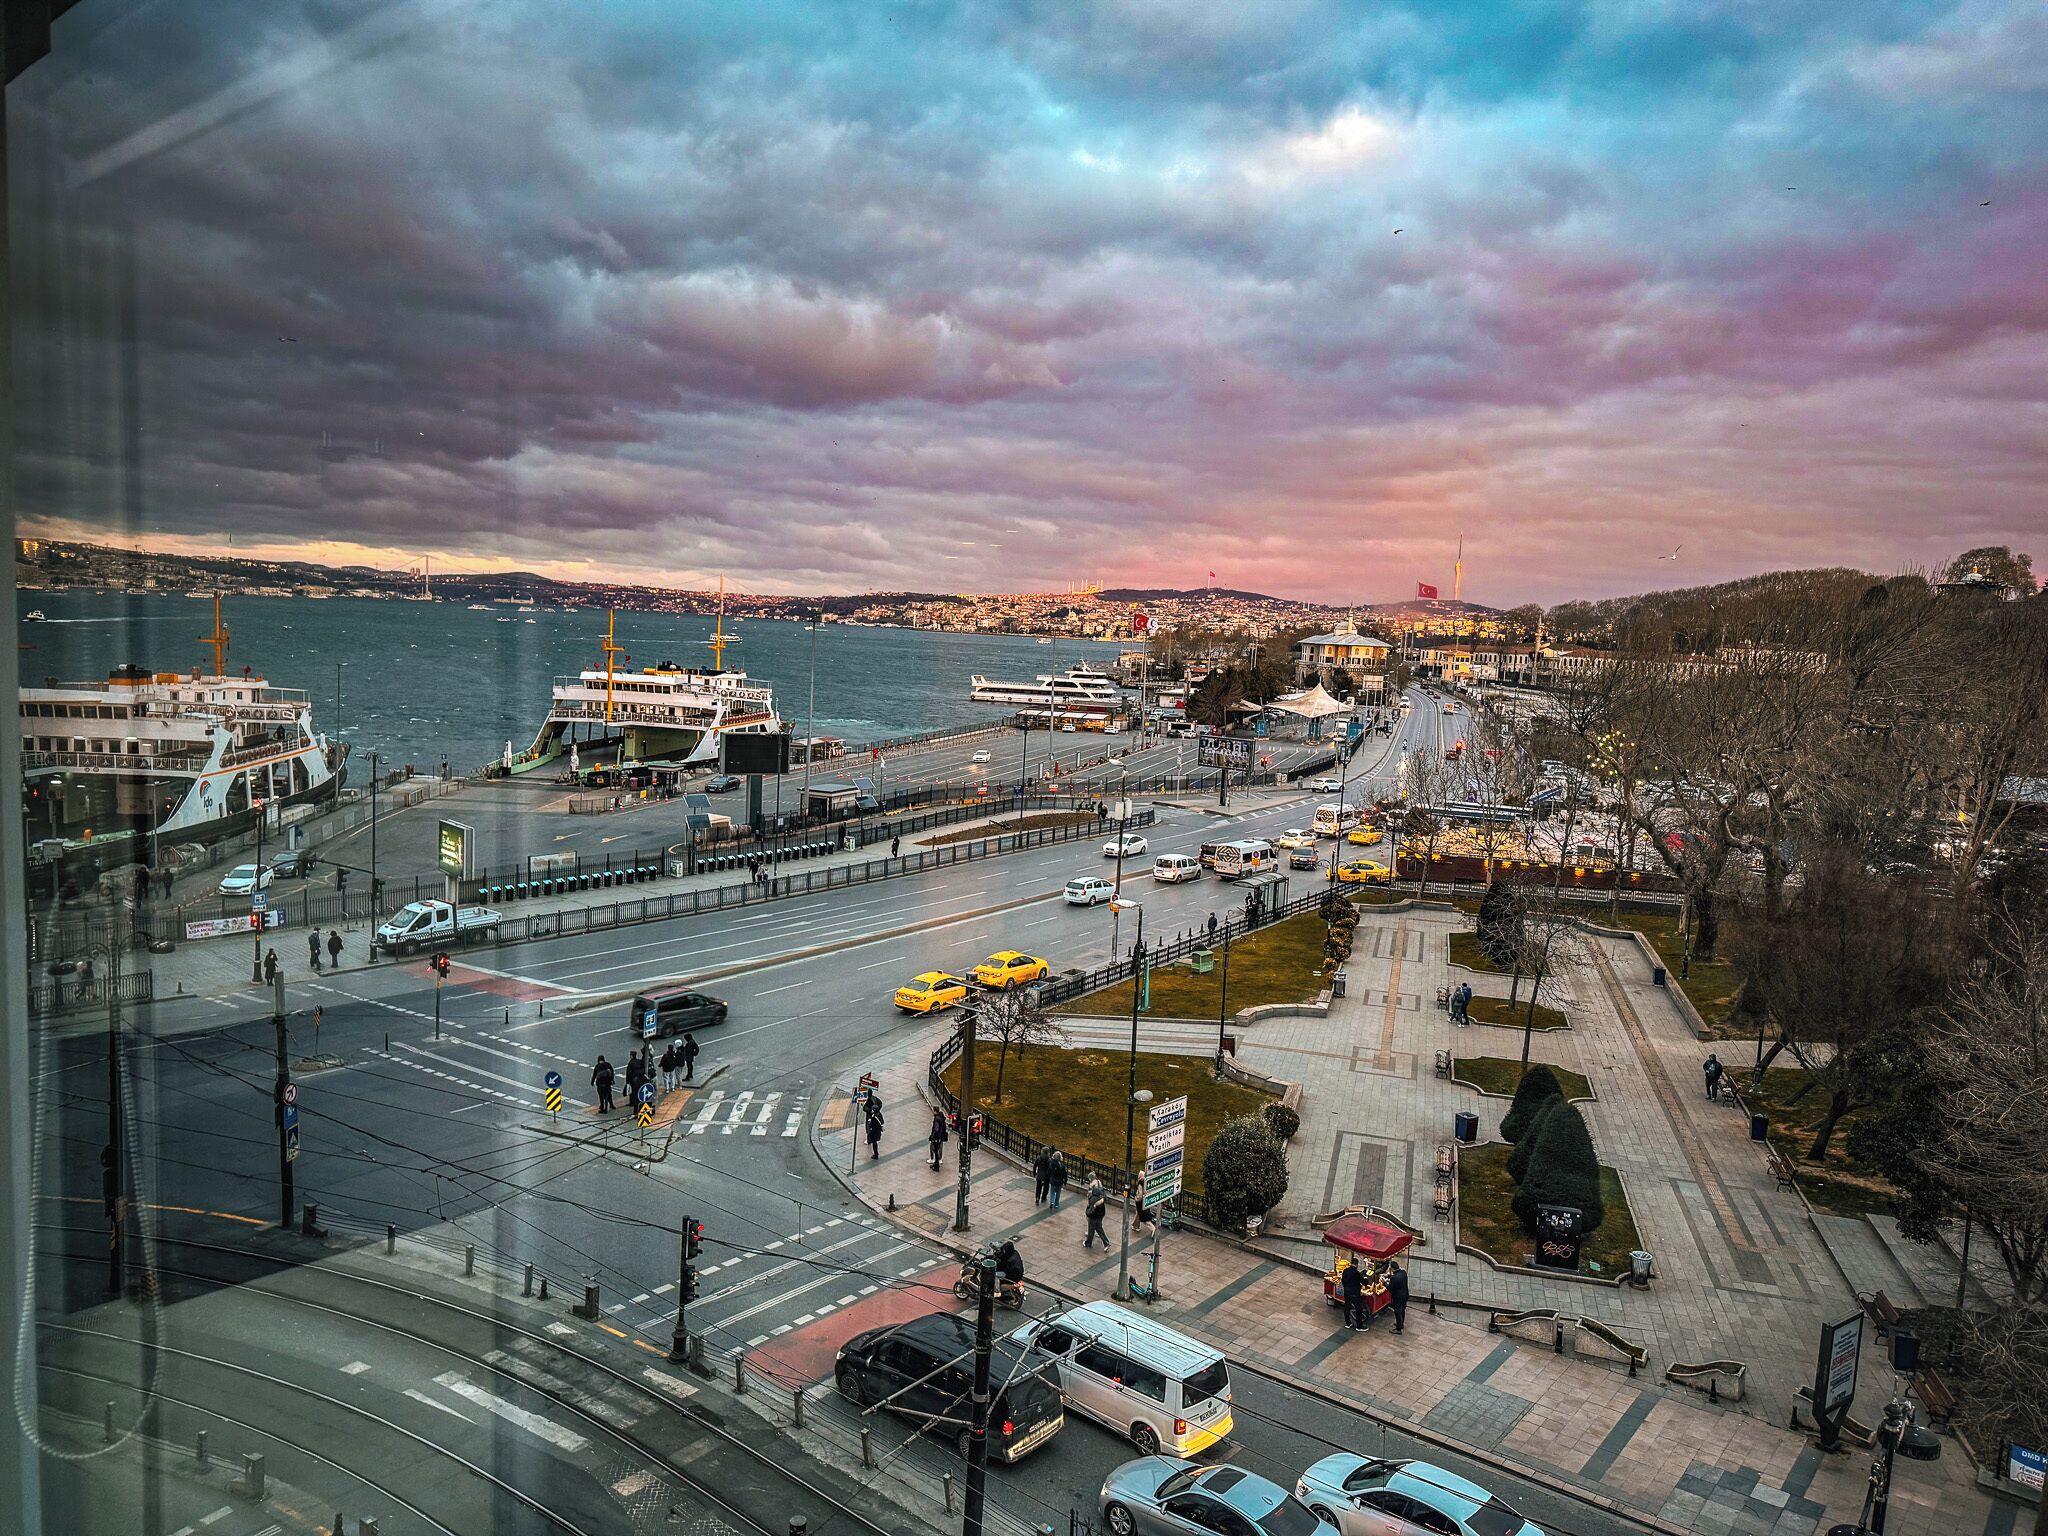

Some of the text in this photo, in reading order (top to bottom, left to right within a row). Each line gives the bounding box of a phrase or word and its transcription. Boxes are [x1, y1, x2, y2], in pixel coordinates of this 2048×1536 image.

[1156, 1103, 1183, 1116] Karaköy
[1154, 1141, 1170, 1152] Fatih
[2021, 1450, 2041, 1462] DMD
